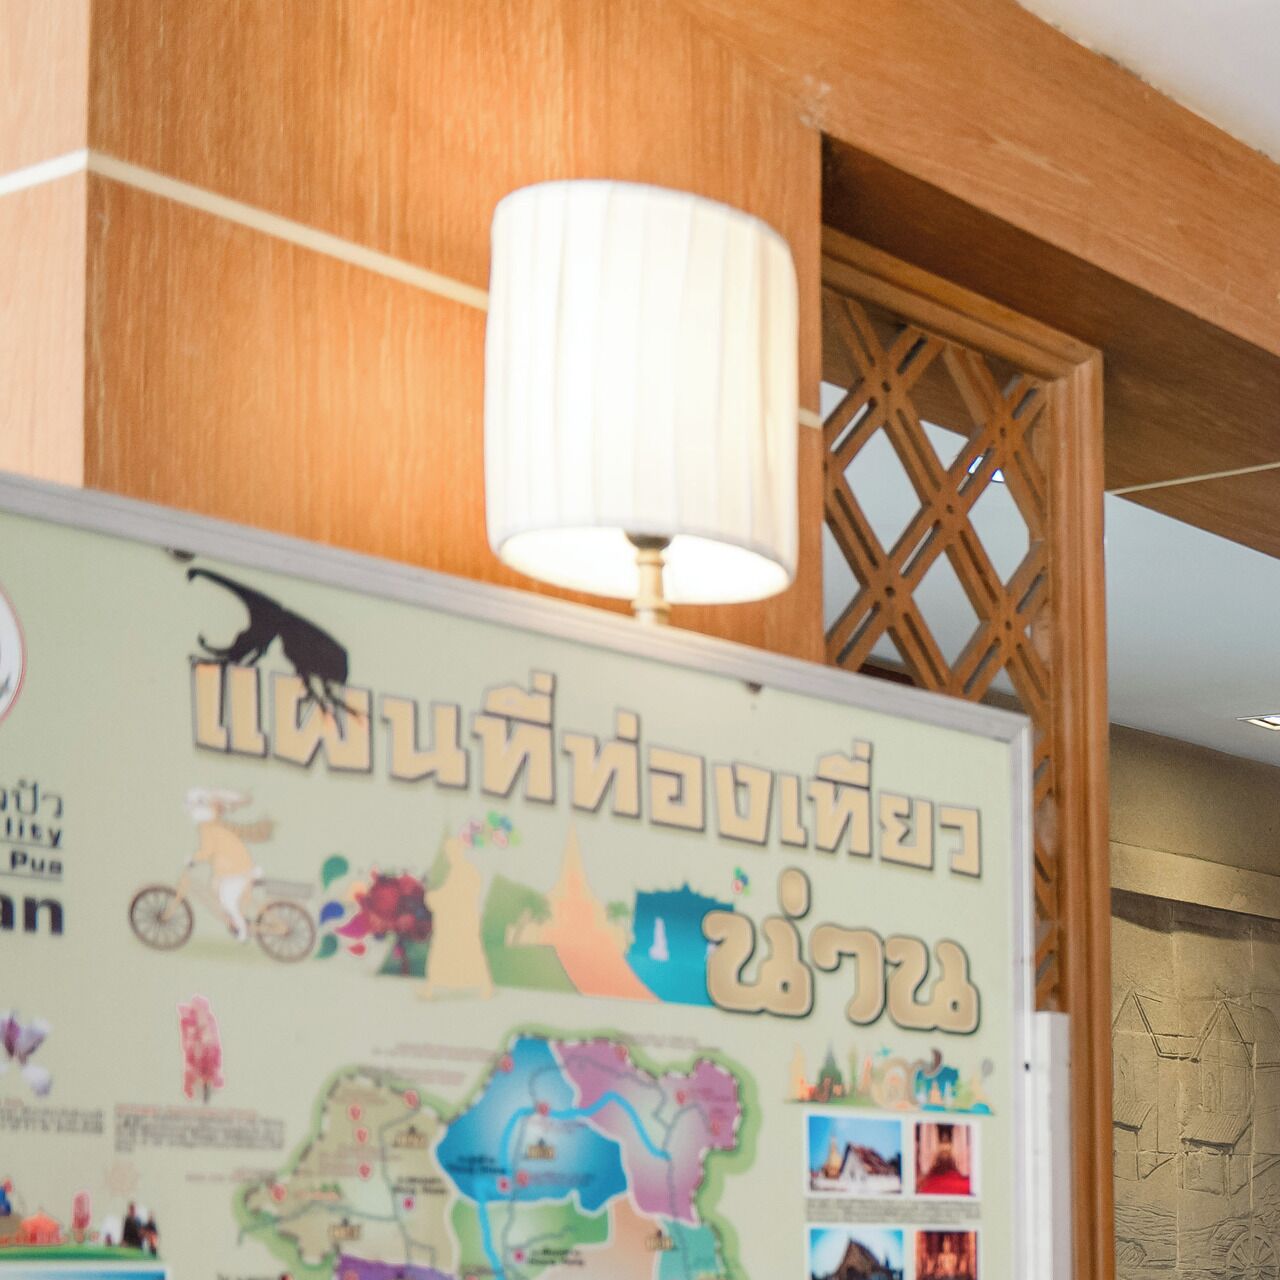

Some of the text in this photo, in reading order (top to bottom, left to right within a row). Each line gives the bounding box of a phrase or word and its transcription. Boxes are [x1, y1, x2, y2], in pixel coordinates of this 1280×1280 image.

[191, 660, 982, 879] แผนที่ท่องเที่ยว
[702, 867, 982, 1035] น่าน
